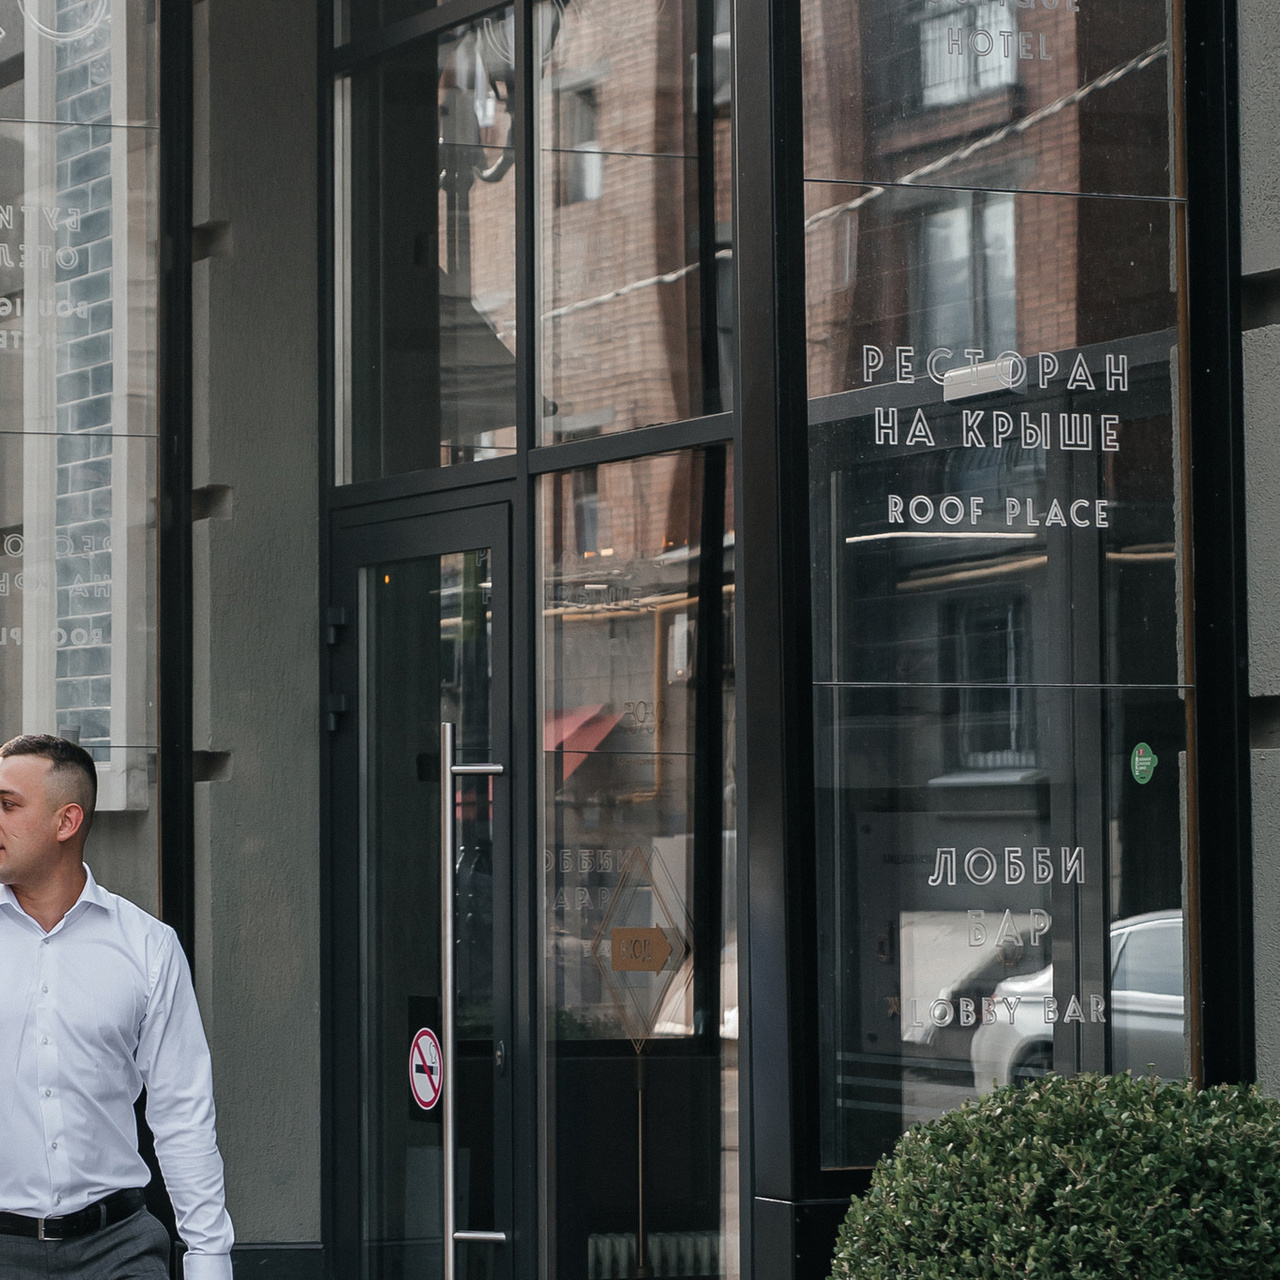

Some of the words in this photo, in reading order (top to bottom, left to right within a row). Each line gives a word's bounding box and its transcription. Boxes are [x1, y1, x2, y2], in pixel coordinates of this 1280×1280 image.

[947, 29, 1053, 61] HOTEL
[862, 344, 1129, 392] РЕСТОРАН
[874, 407, 935, 446] НА
[962, 410, 1120, 451] КРЫШЕ
[888, 494, 984, 525] ROOF
[1006, 498, 1109, 528] PLACE
[928, 846, 1085, 886] ЛОББИ
[967, 908, 1053, 947] БАР
[910, 995, 1021, 1028] LOBBY
[1043, 993, 1106, 1024] BAR
